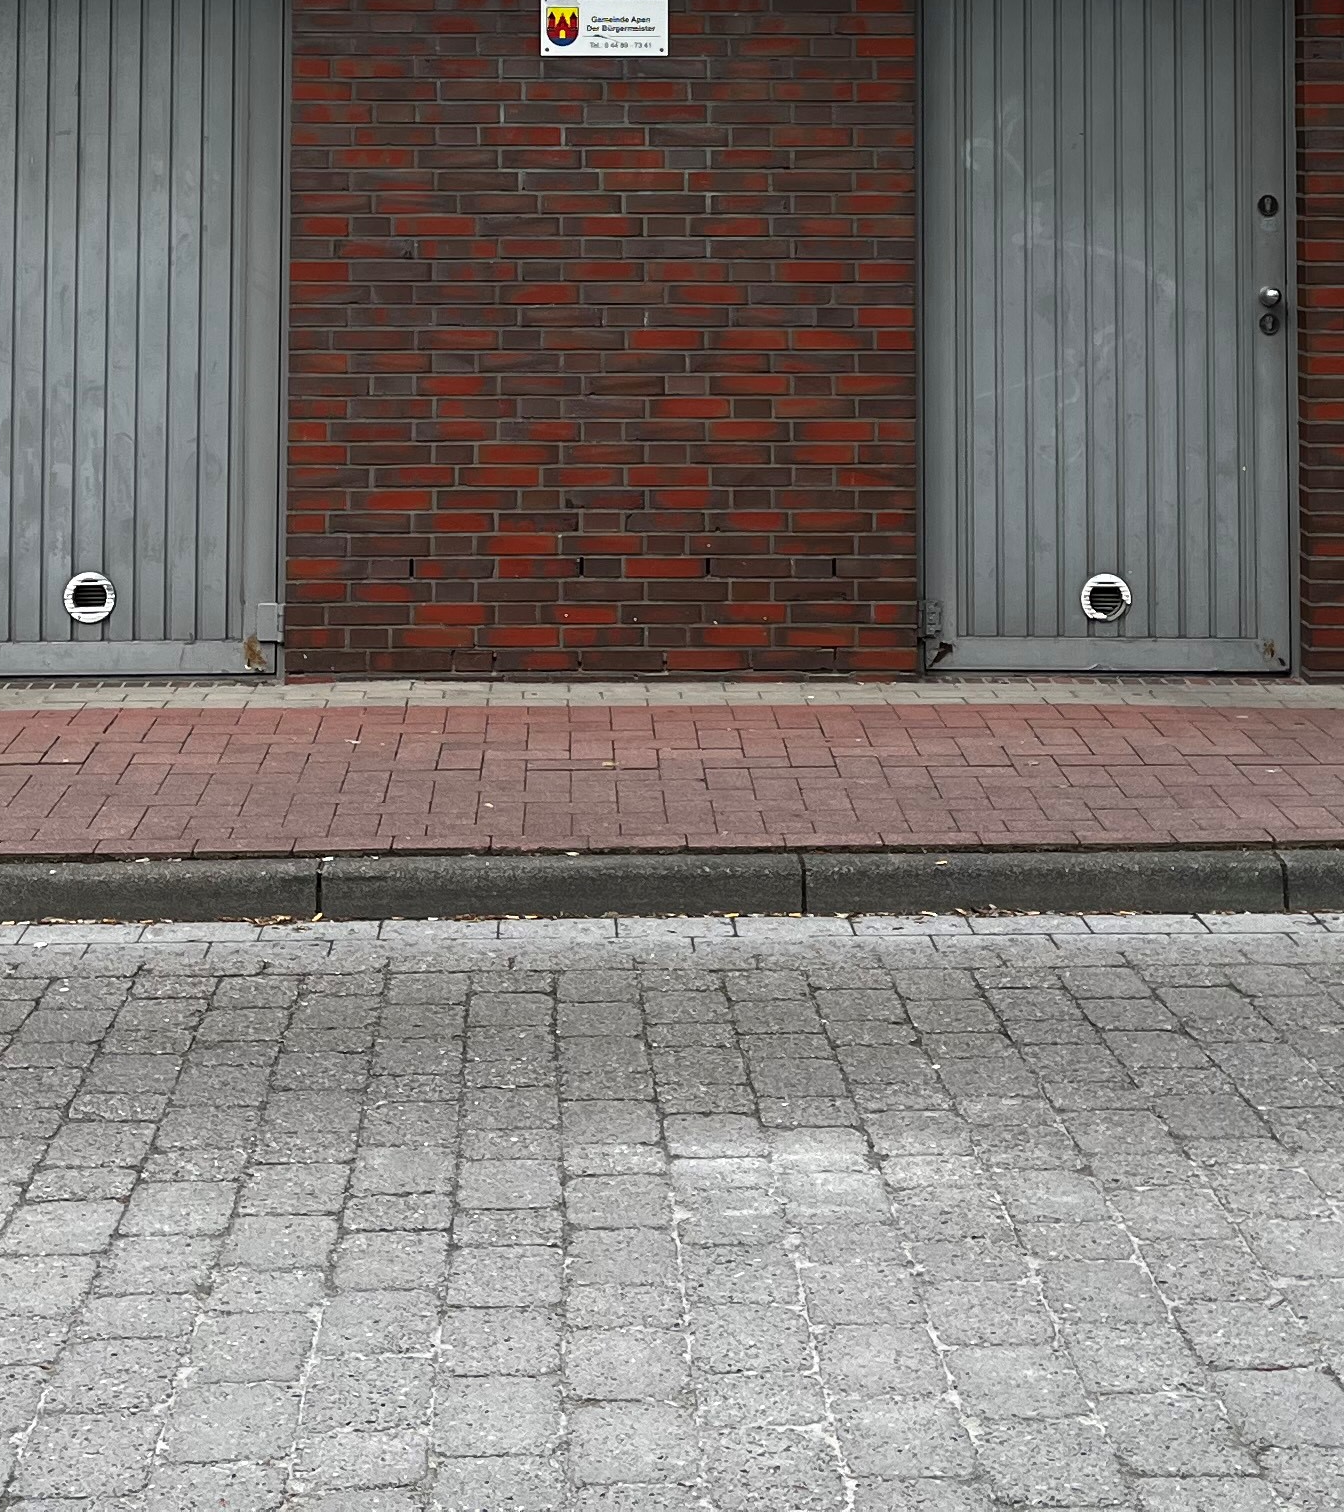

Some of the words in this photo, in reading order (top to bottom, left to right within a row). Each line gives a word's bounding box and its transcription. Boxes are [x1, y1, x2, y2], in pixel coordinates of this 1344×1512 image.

[591, 15, 629, 23] Gemeinde
[586, 24, 599, 32] Der
[602, 24, 655, 33] Bürgermeister
